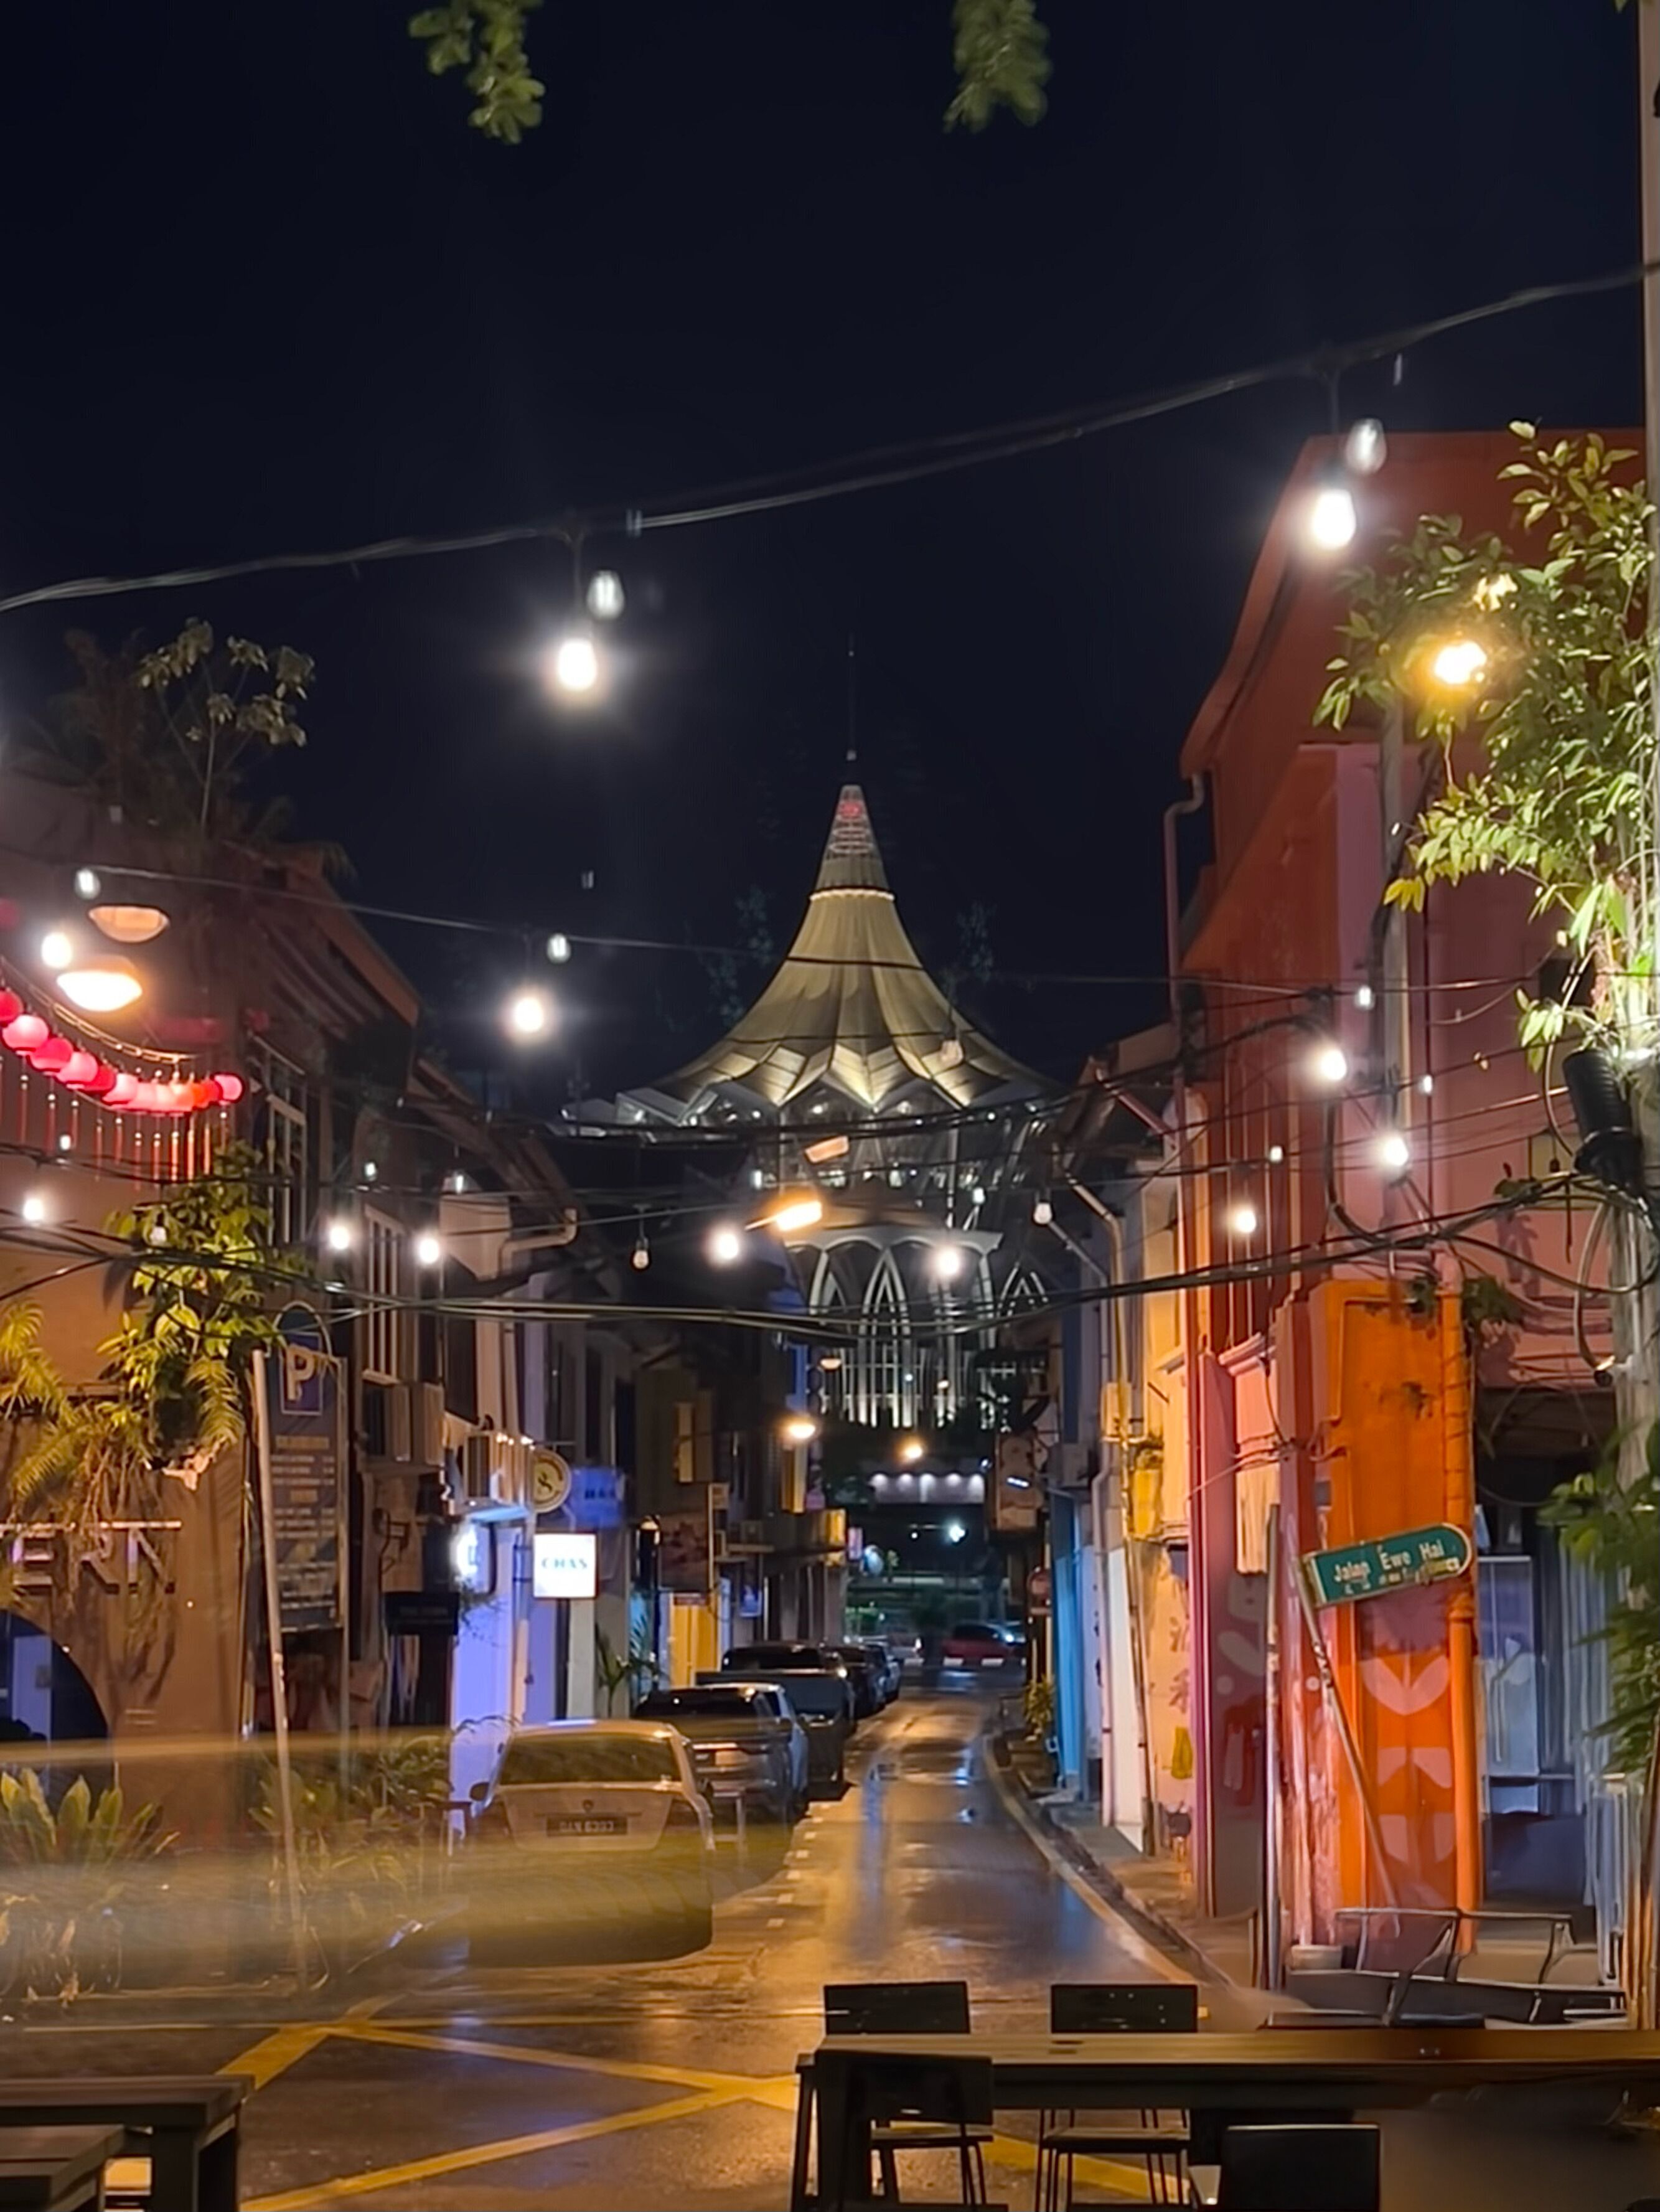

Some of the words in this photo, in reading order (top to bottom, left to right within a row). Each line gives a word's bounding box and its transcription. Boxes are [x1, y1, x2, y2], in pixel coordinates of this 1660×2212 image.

[287, 1345, 315, 1400] P
[541, 1557, 588, 1569] CHAS
[1334, 1561, 1371, 1582] Jalan
